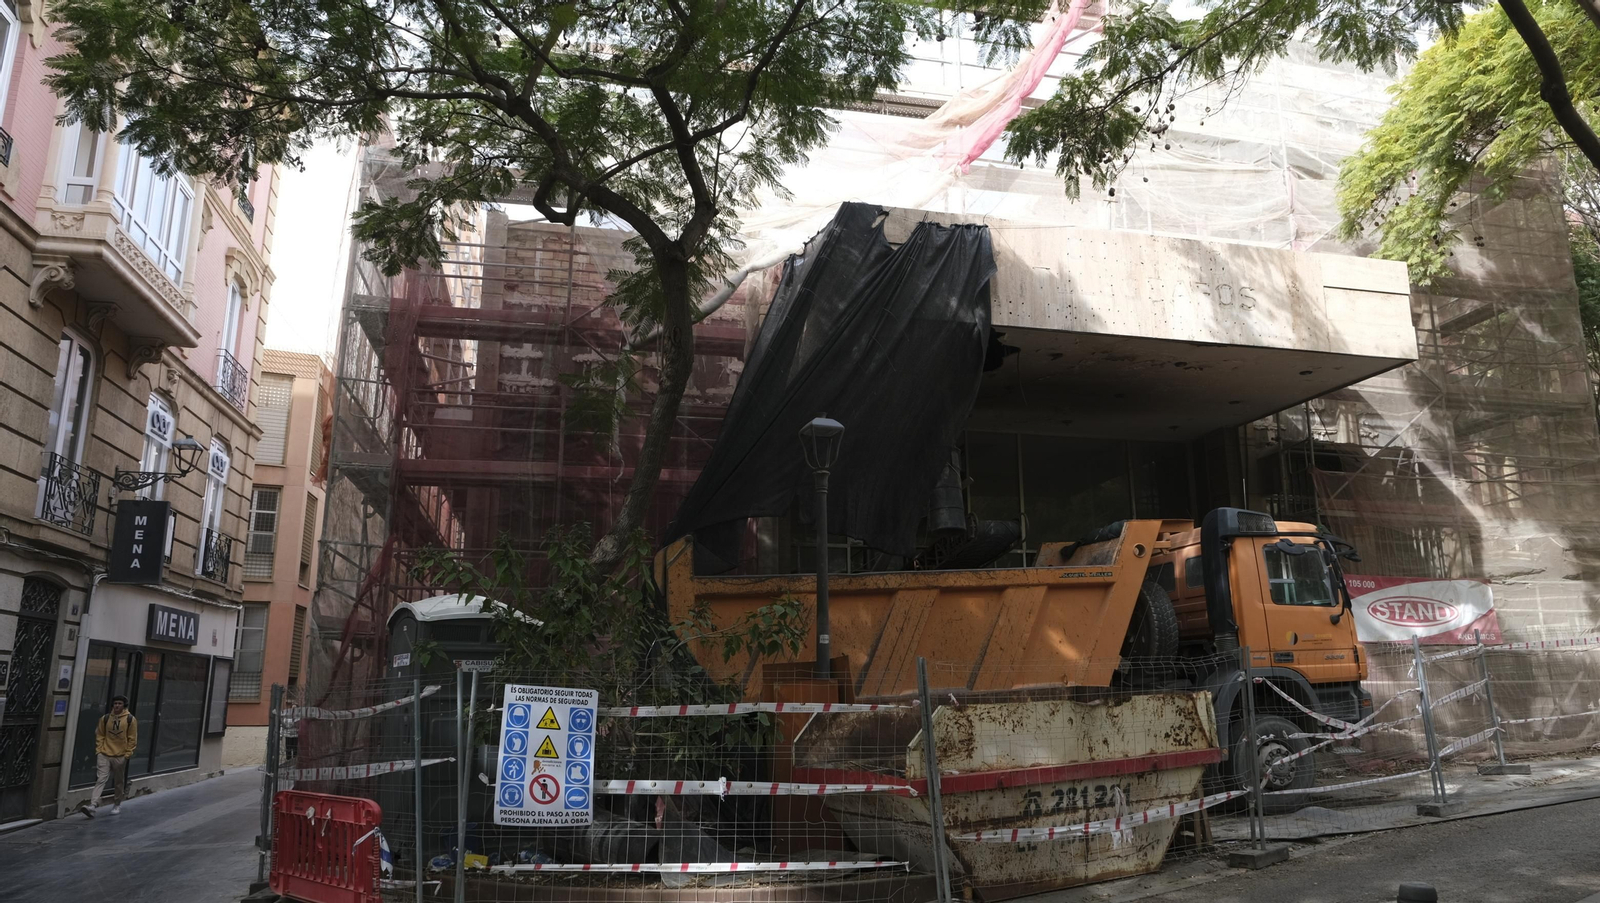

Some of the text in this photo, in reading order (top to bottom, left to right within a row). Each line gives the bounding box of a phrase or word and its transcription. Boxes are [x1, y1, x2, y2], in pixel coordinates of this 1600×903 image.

[130, 515, 148, 569] MENA
[1349, 580, 1362, 588] 105
[1363, 581, 1376, 589] 000
[1375, 601, 1451, 622] STAND
[156, 610, 195, 641] MENA
[518, 687, 554, 696] OBLIGATORIO
[558, 698, 588, 706] SEGURIDAD
